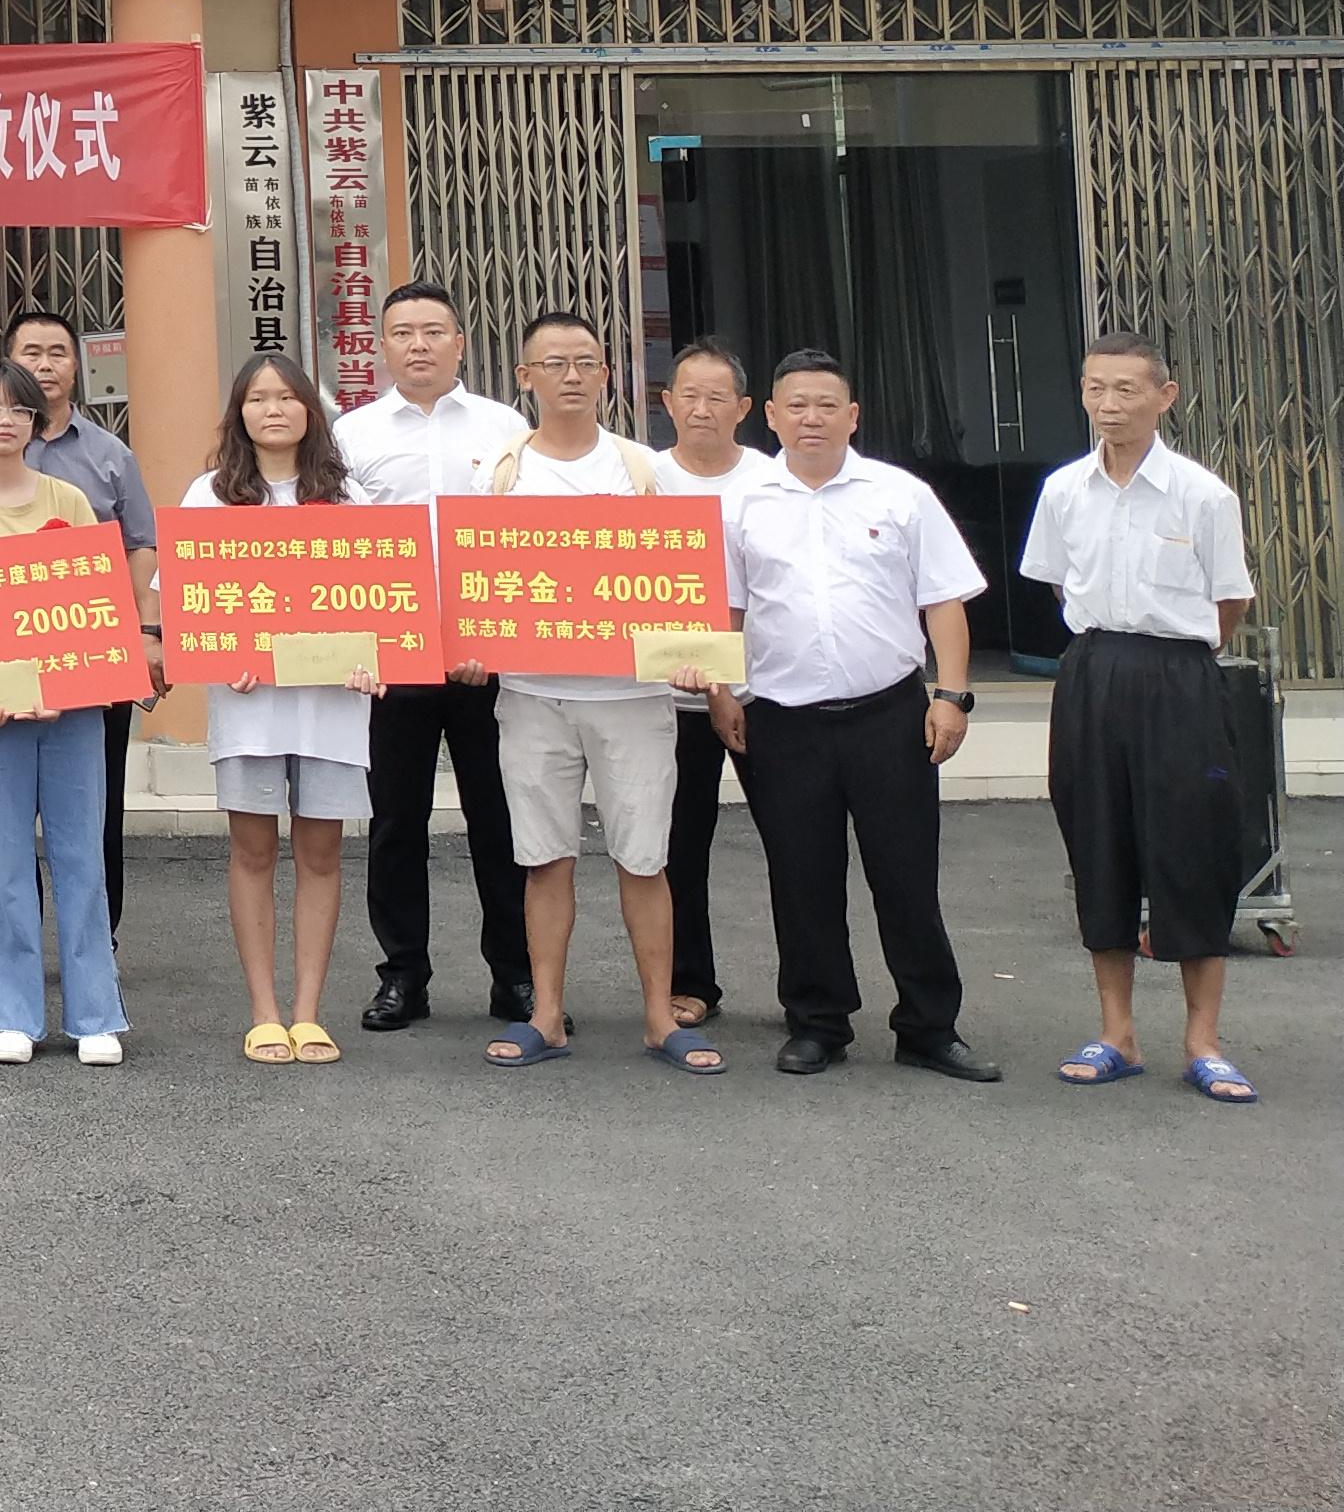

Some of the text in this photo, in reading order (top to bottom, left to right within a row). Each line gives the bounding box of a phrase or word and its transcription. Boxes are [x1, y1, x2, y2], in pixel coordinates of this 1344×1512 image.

[240, 93, 280, 169] 紫云
[175, 537, 417, 560] 硐口村2023年度助学活动
[455, 527, 706, 550] 硐口村2023年度助学活动
[181, 581, 419, 615] 助学金：2000元
[459, 570, 707, 605] 助学金：4000元
[458, 617, 518, 638] 张志放
